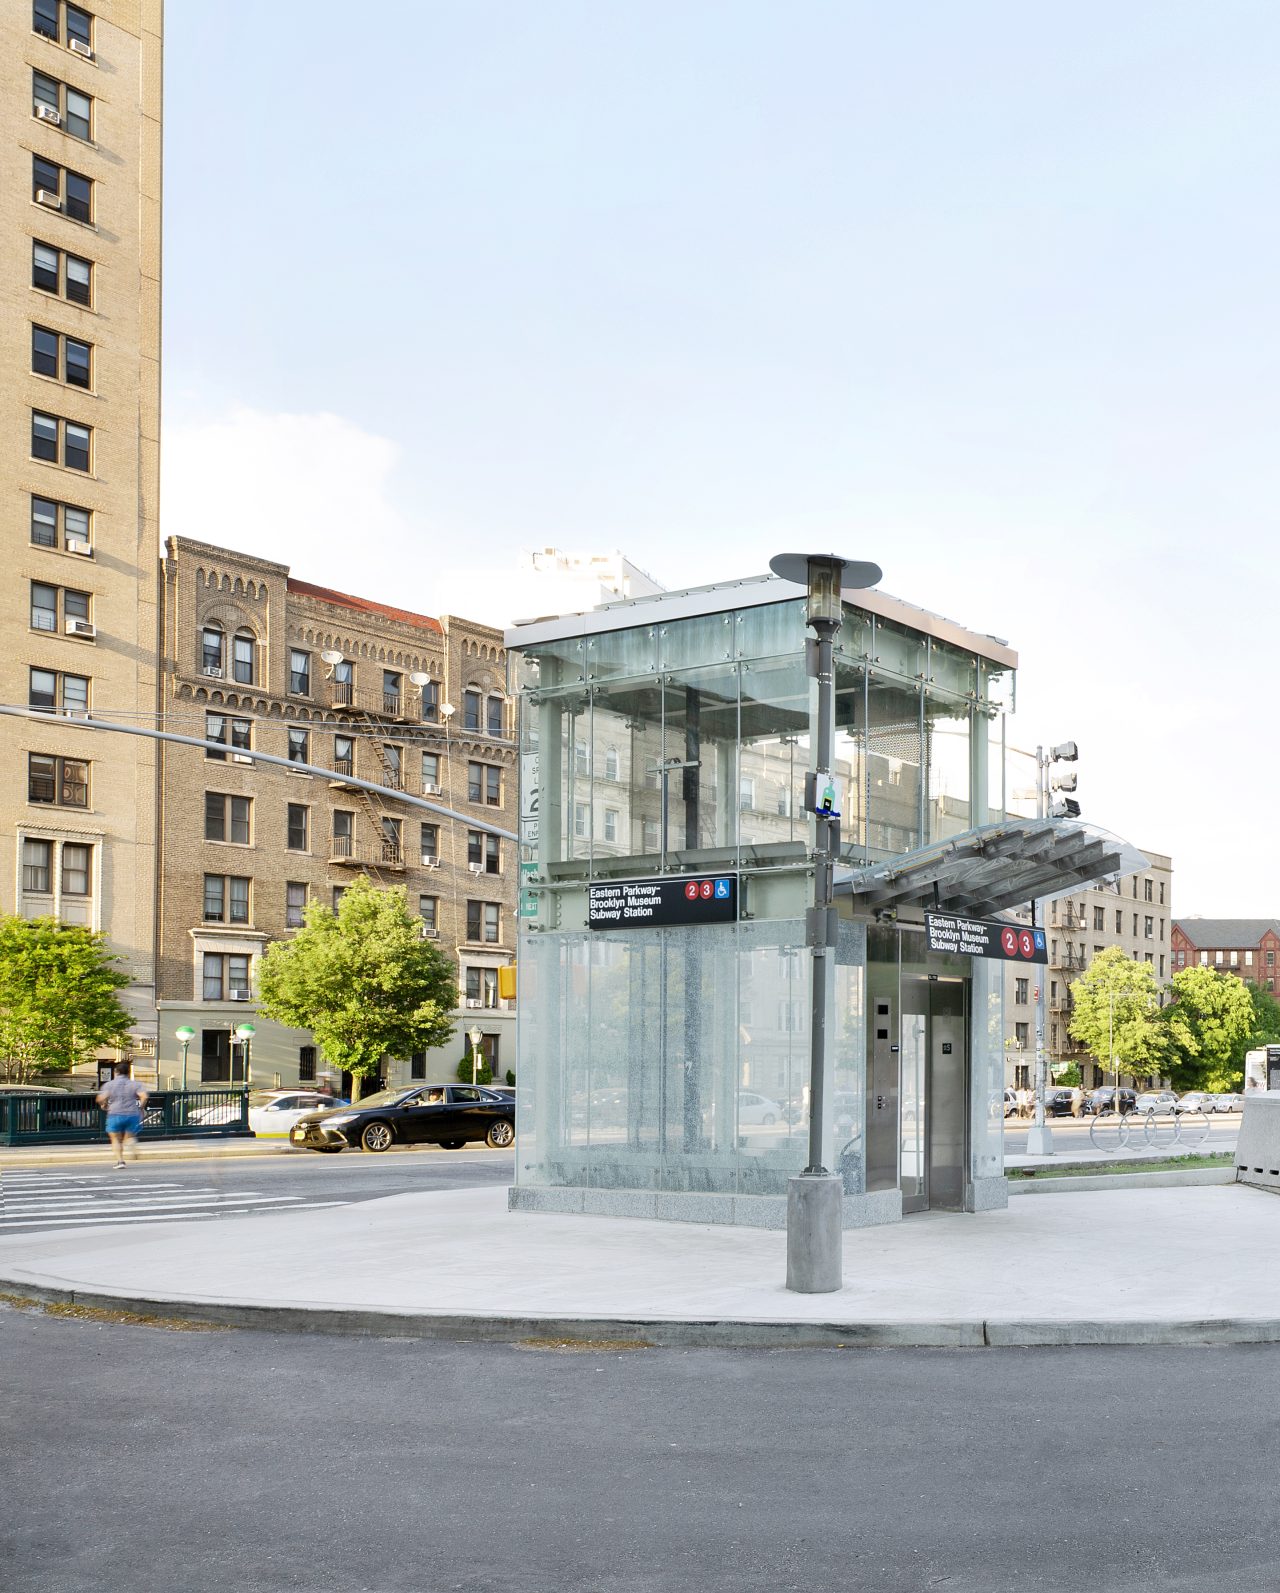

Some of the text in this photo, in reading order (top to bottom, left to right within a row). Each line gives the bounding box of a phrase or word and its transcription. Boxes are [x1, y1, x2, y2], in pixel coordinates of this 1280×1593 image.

[590, 886, 661, 898] Eastern Parkway-
[688, 884, 710, 896] 2 3
[590, 896, 662, 909] Brooklyn Museum
[590, 906, 653, 920] Subway Station
[928, 915, 987, 933] Eastern Parkway-
[930, 927, 989, 944] Brooklyn Museum
[1006, 933, 1030, 952] 2 3
[930, 938, 984, 954] Subway Station
